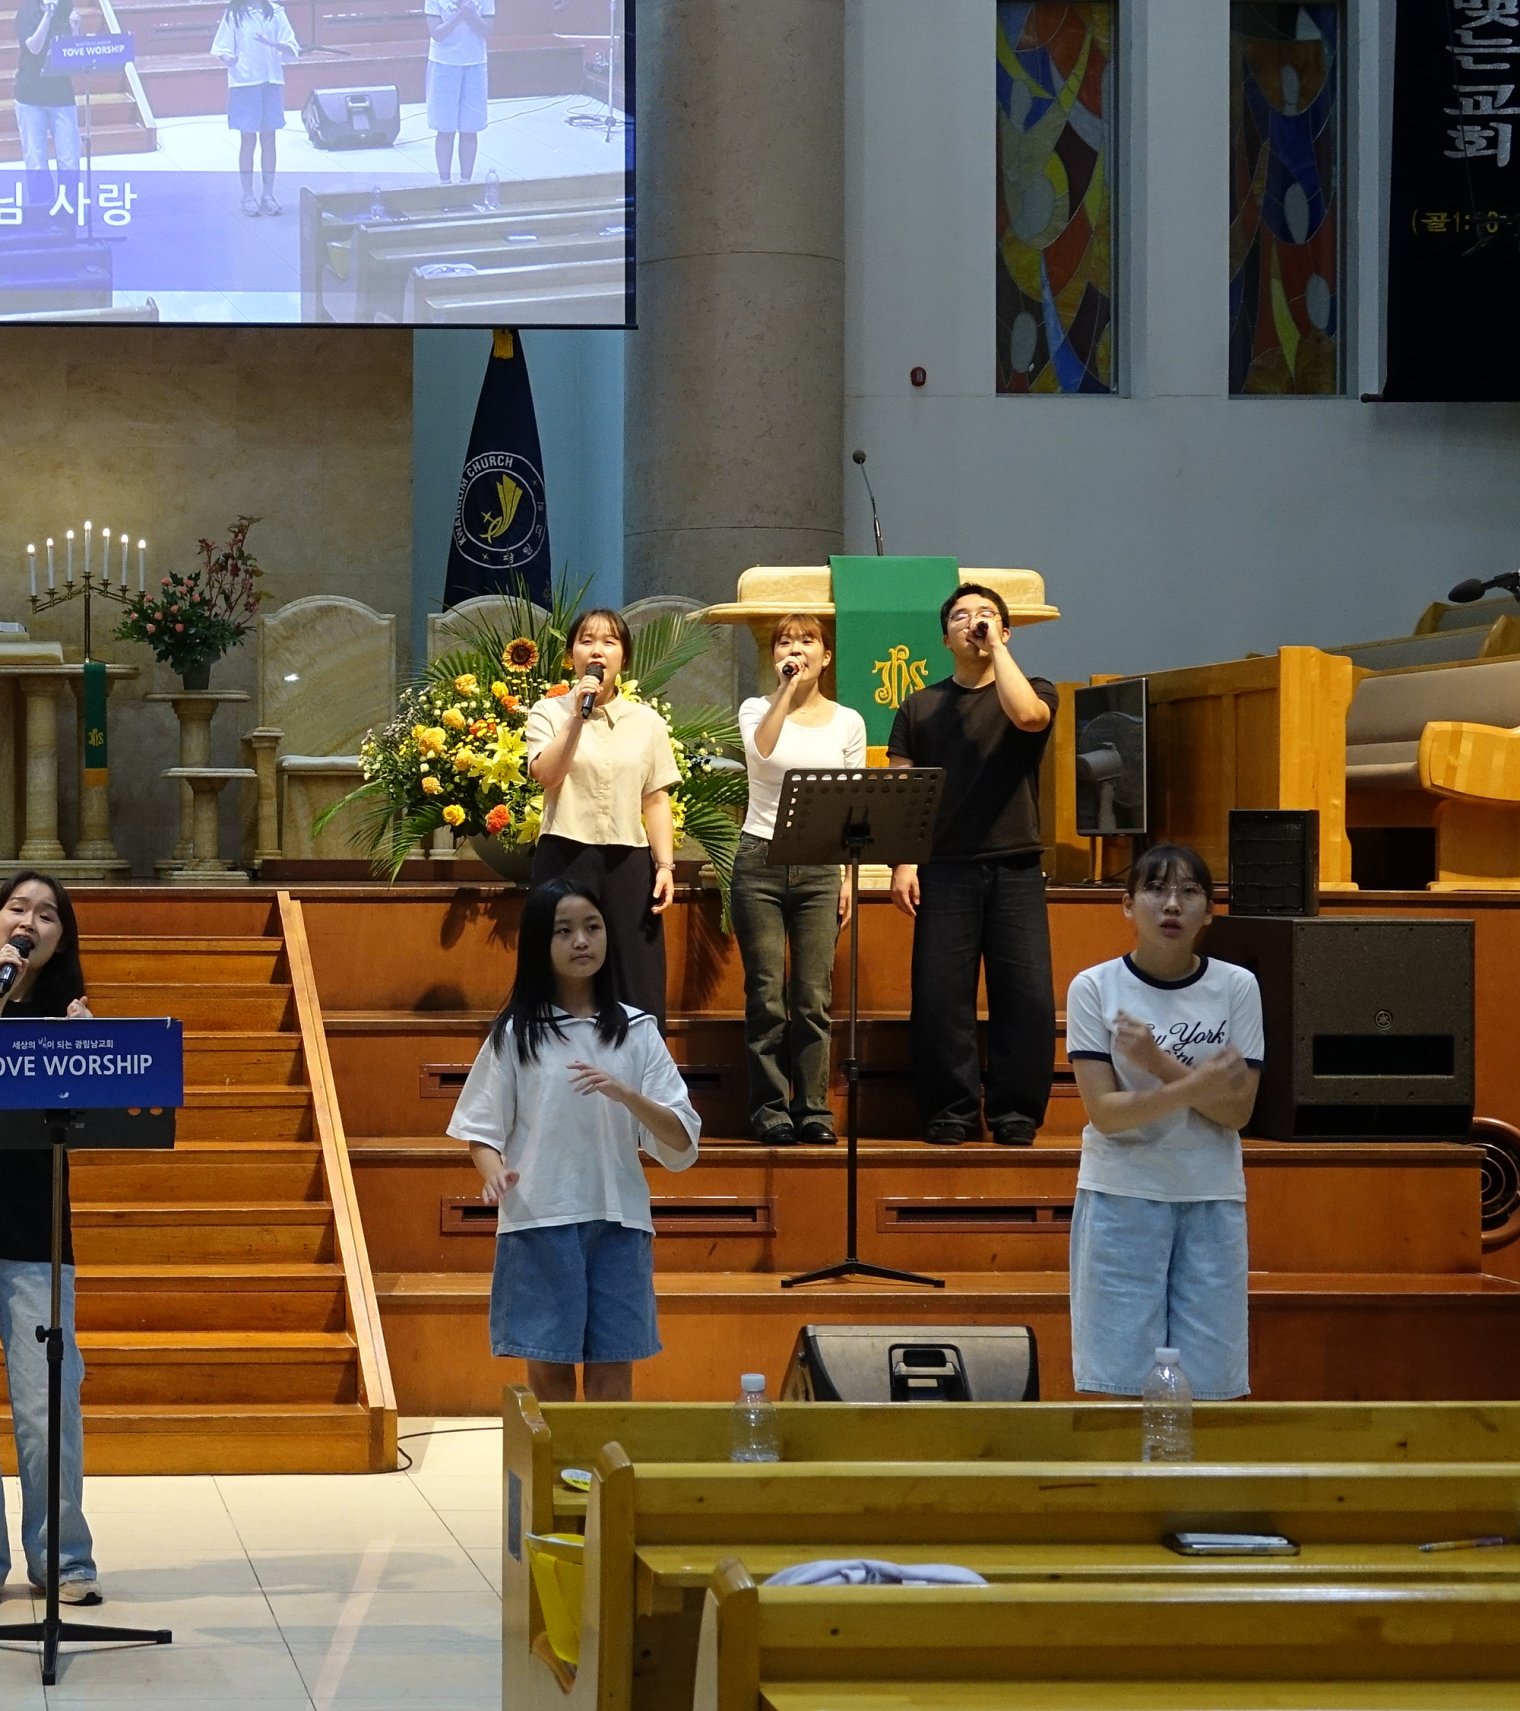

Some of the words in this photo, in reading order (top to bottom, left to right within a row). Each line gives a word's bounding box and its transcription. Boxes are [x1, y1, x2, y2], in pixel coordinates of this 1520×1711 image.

[1442, 84, 1520, 168] 교회
[49, 182, 138, 227] 사랑
[466, 455, 514, 477] CHURCH
[12, 1040, 36, 1050] 세상의
[57, 1040, 73, 1050] 되는
[1169, 1019, 1227, 1052] York
[43, 1054, 153, 1076] WORSHIP
